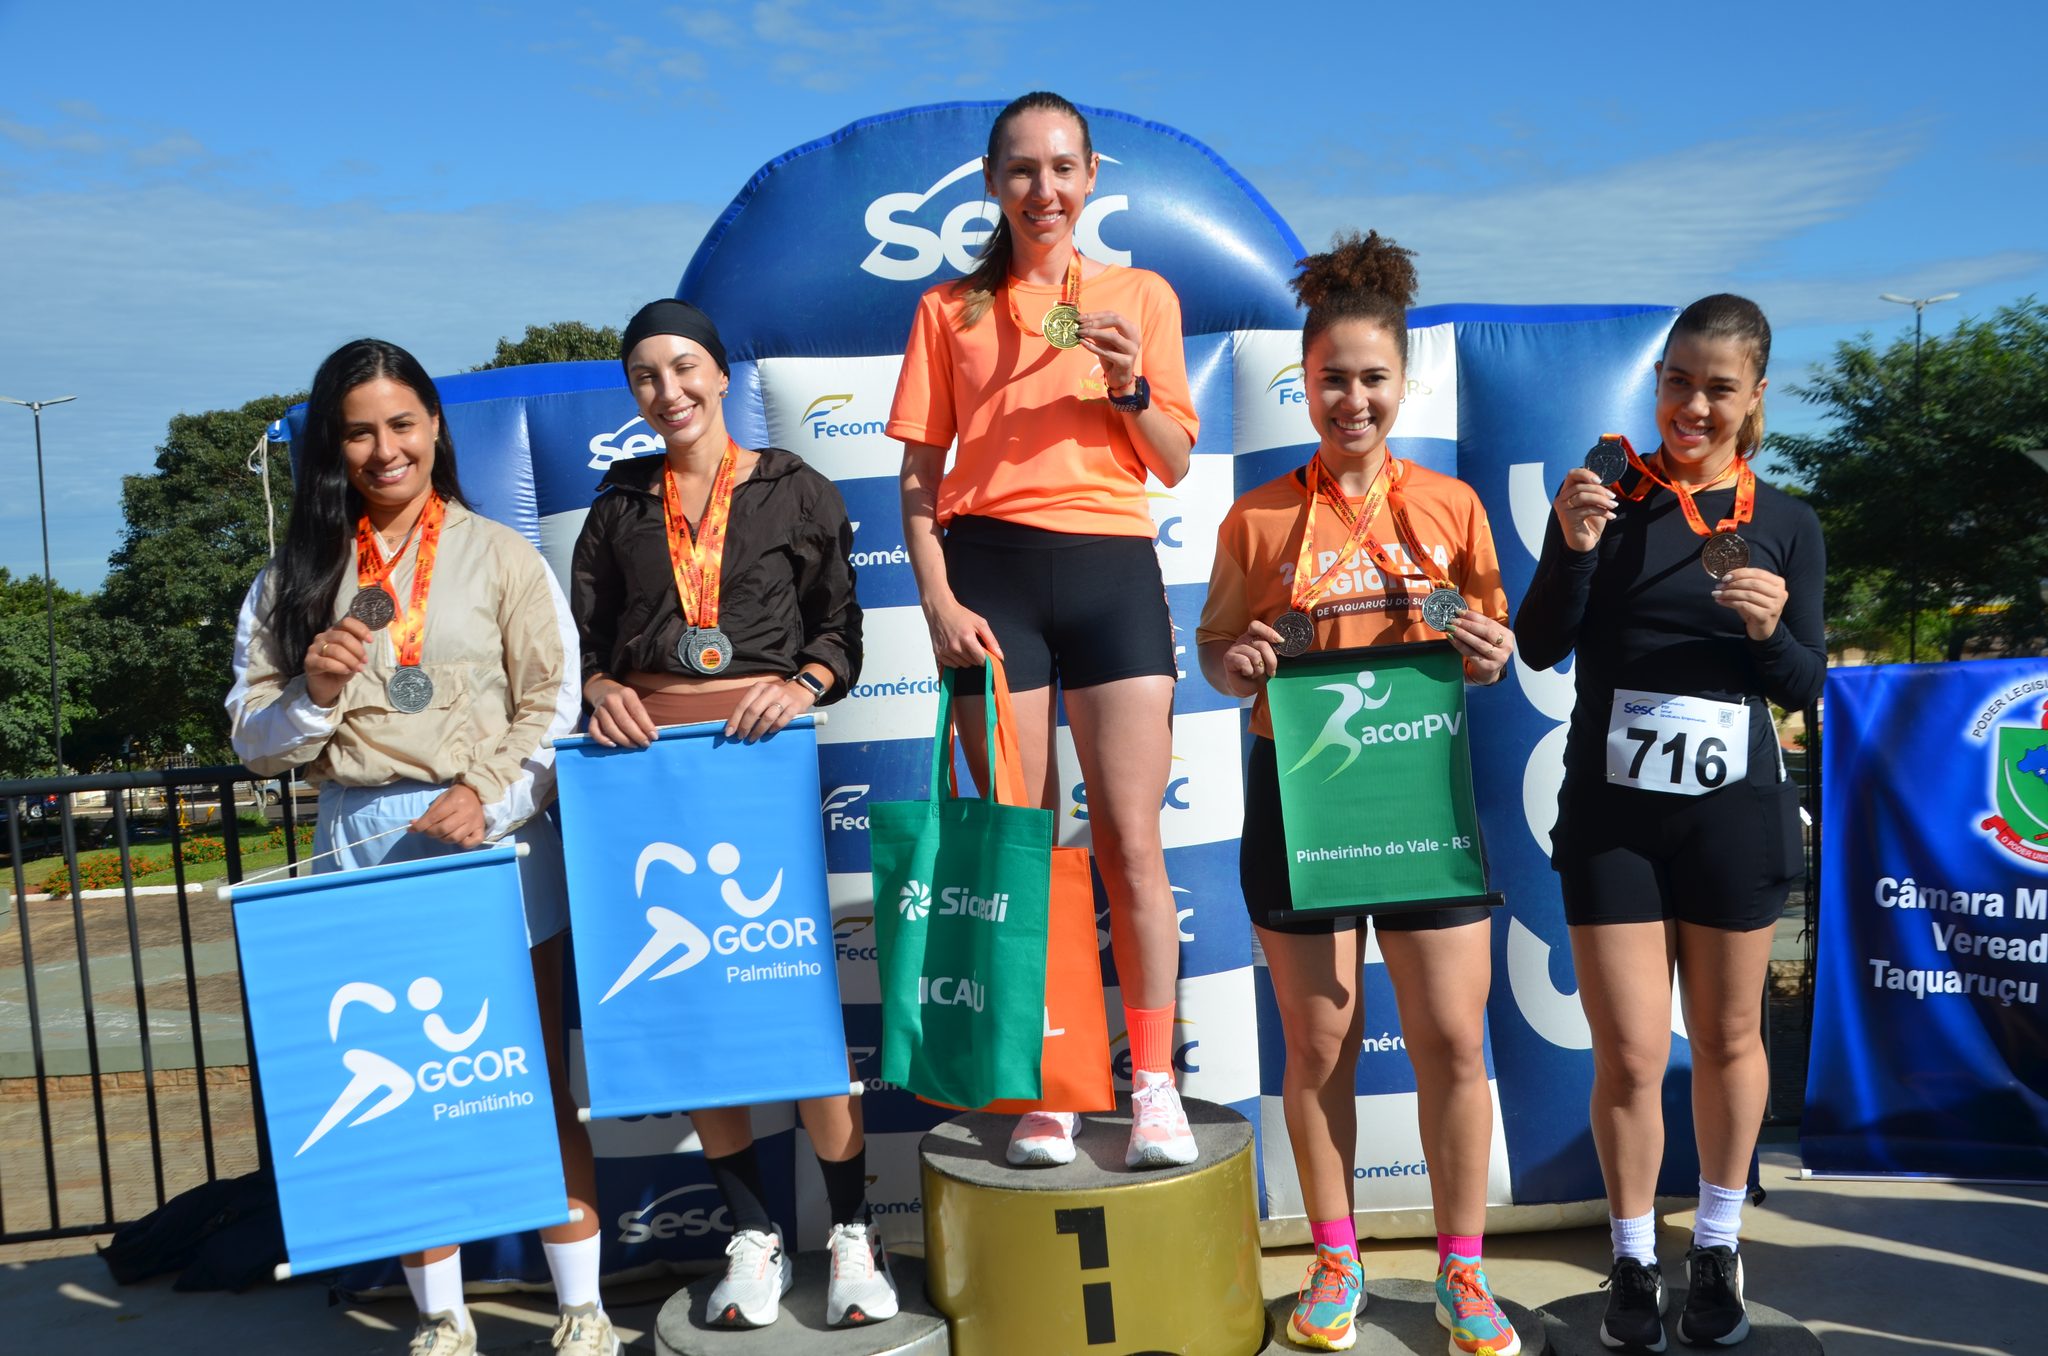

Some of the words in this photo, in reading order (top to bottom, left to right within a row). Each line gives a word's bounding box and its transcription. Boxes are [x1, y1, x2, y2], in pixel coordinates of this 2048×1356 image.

[814, 420, 885, 439] Fecom
[1317, 608, 1330, 617] DE
[1333, 599, 1392, 613] TAQUARUÇU
[1361, 712, 1462, 745] acorPV
[1973, 699, 2006, 738] PODER
[2005, 679, 2048, 701] LEGISL
[1626, 727, 1727, 788] 716
[1296, 842, 1382, 863] Pinheirinho
[1386, 842, 1404, 856] do
[1407, 838, 1439, 853] Vale
[1452, 836, 1471, 850] RS
[1874, 877, 2004, 917] Câmara
[2015, 887, 2048, 920] M
[712, 916, 818, 956] GCOR
[1932, 921, 2048, 963] Veread
[726, 960, 822, 984] Palmitinho
[1869, 958, 2038, 1007] Taquaruçu
[416, 1045, 529, 1093] GCOR
[433, 1089, 534, 1121] Palmitinho
[1055, 1206, 1116, 1345] 1
